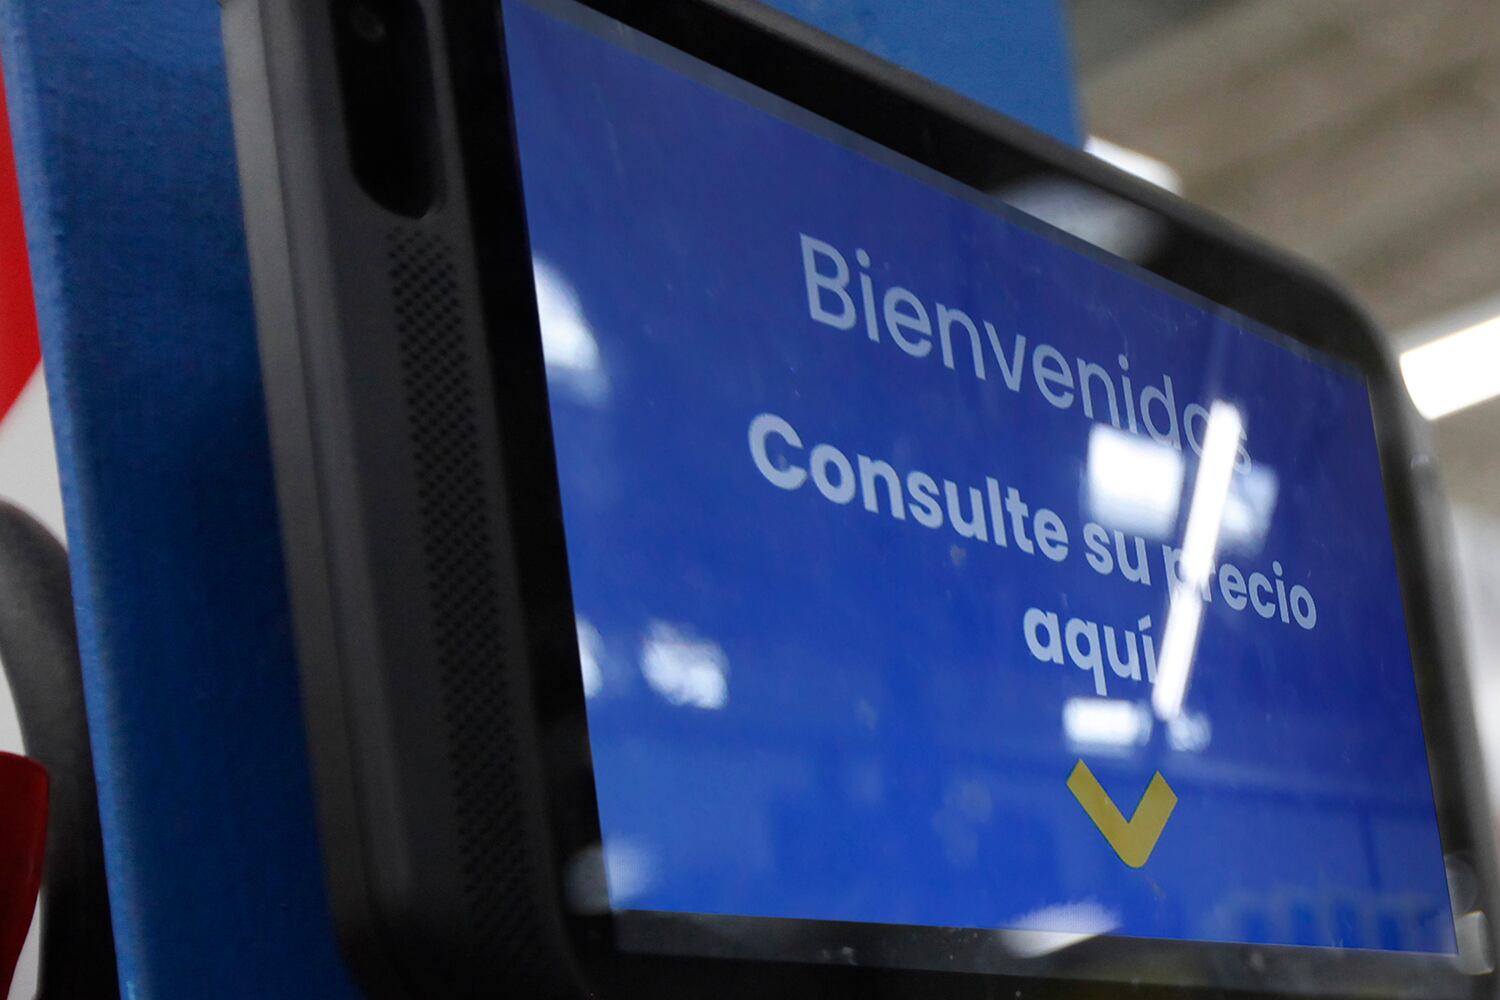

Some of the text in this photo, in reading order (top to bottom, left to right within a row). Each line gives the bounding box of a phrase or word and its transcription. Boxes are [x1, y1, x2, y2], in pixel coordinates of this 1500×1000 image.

[748, 413, 1068, 562] Consulte
[1083, 523, 1151, 586] su
[1023, 607, 1158, 696] aquí
